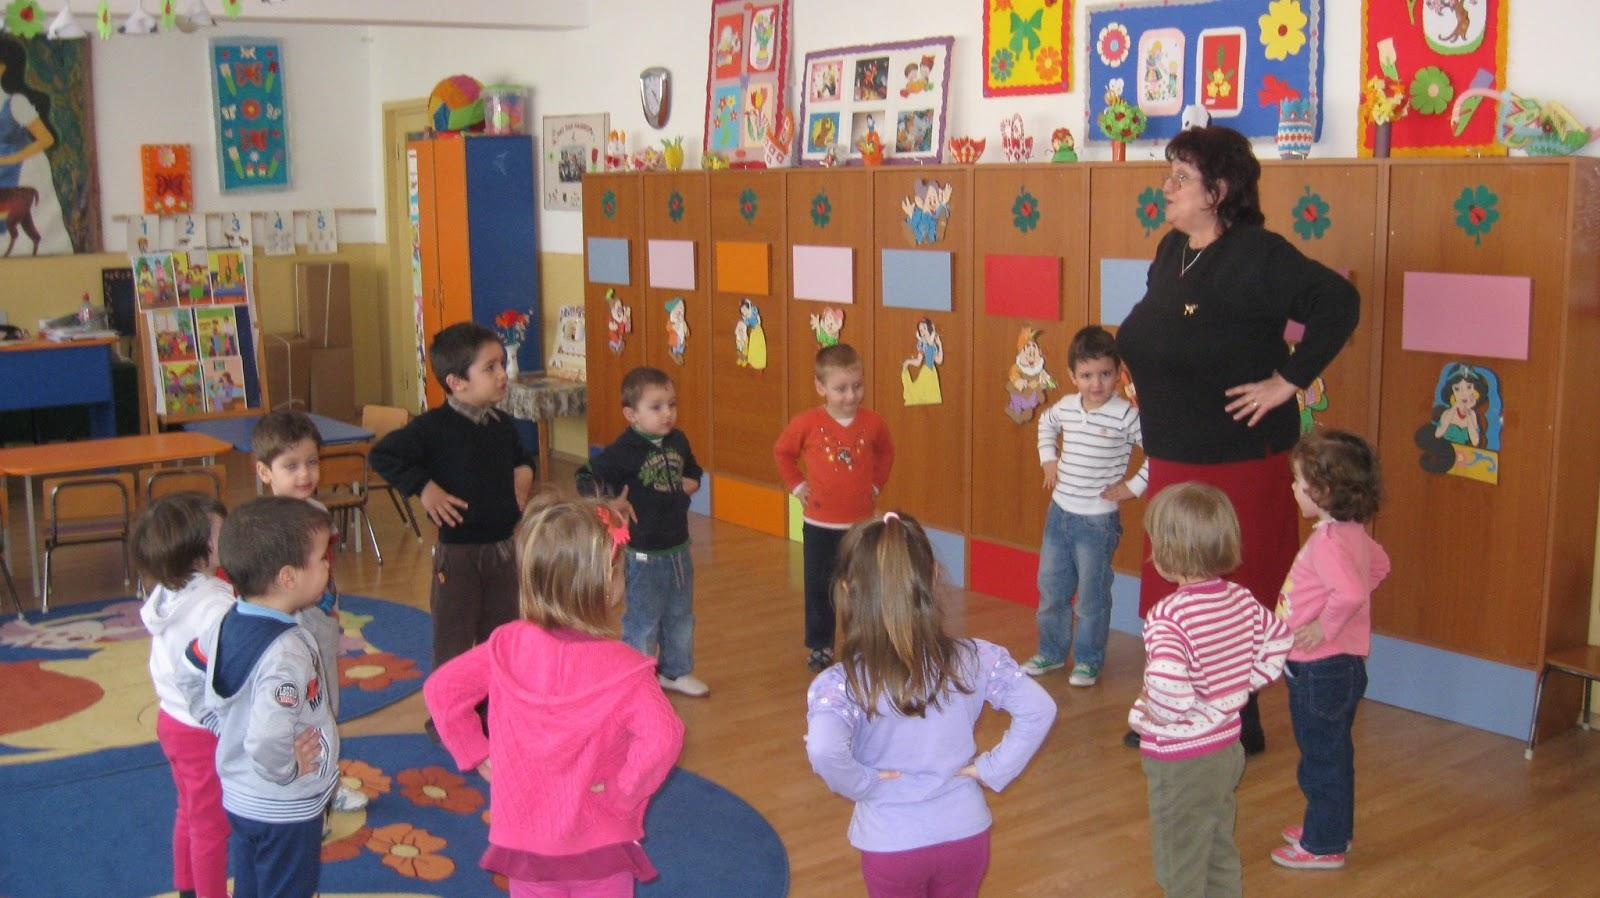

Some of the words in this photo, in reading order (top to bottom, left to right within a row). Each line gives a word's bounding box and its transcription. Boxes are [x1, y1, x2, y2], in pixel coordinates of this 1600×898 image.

[141, 220, 148, 236] 1
[186, 219, 195, 235] 2
[231, 218, 241, 232] 3
[273, 216, 283, 231] 4
[316, 215, 326, 230] 5
